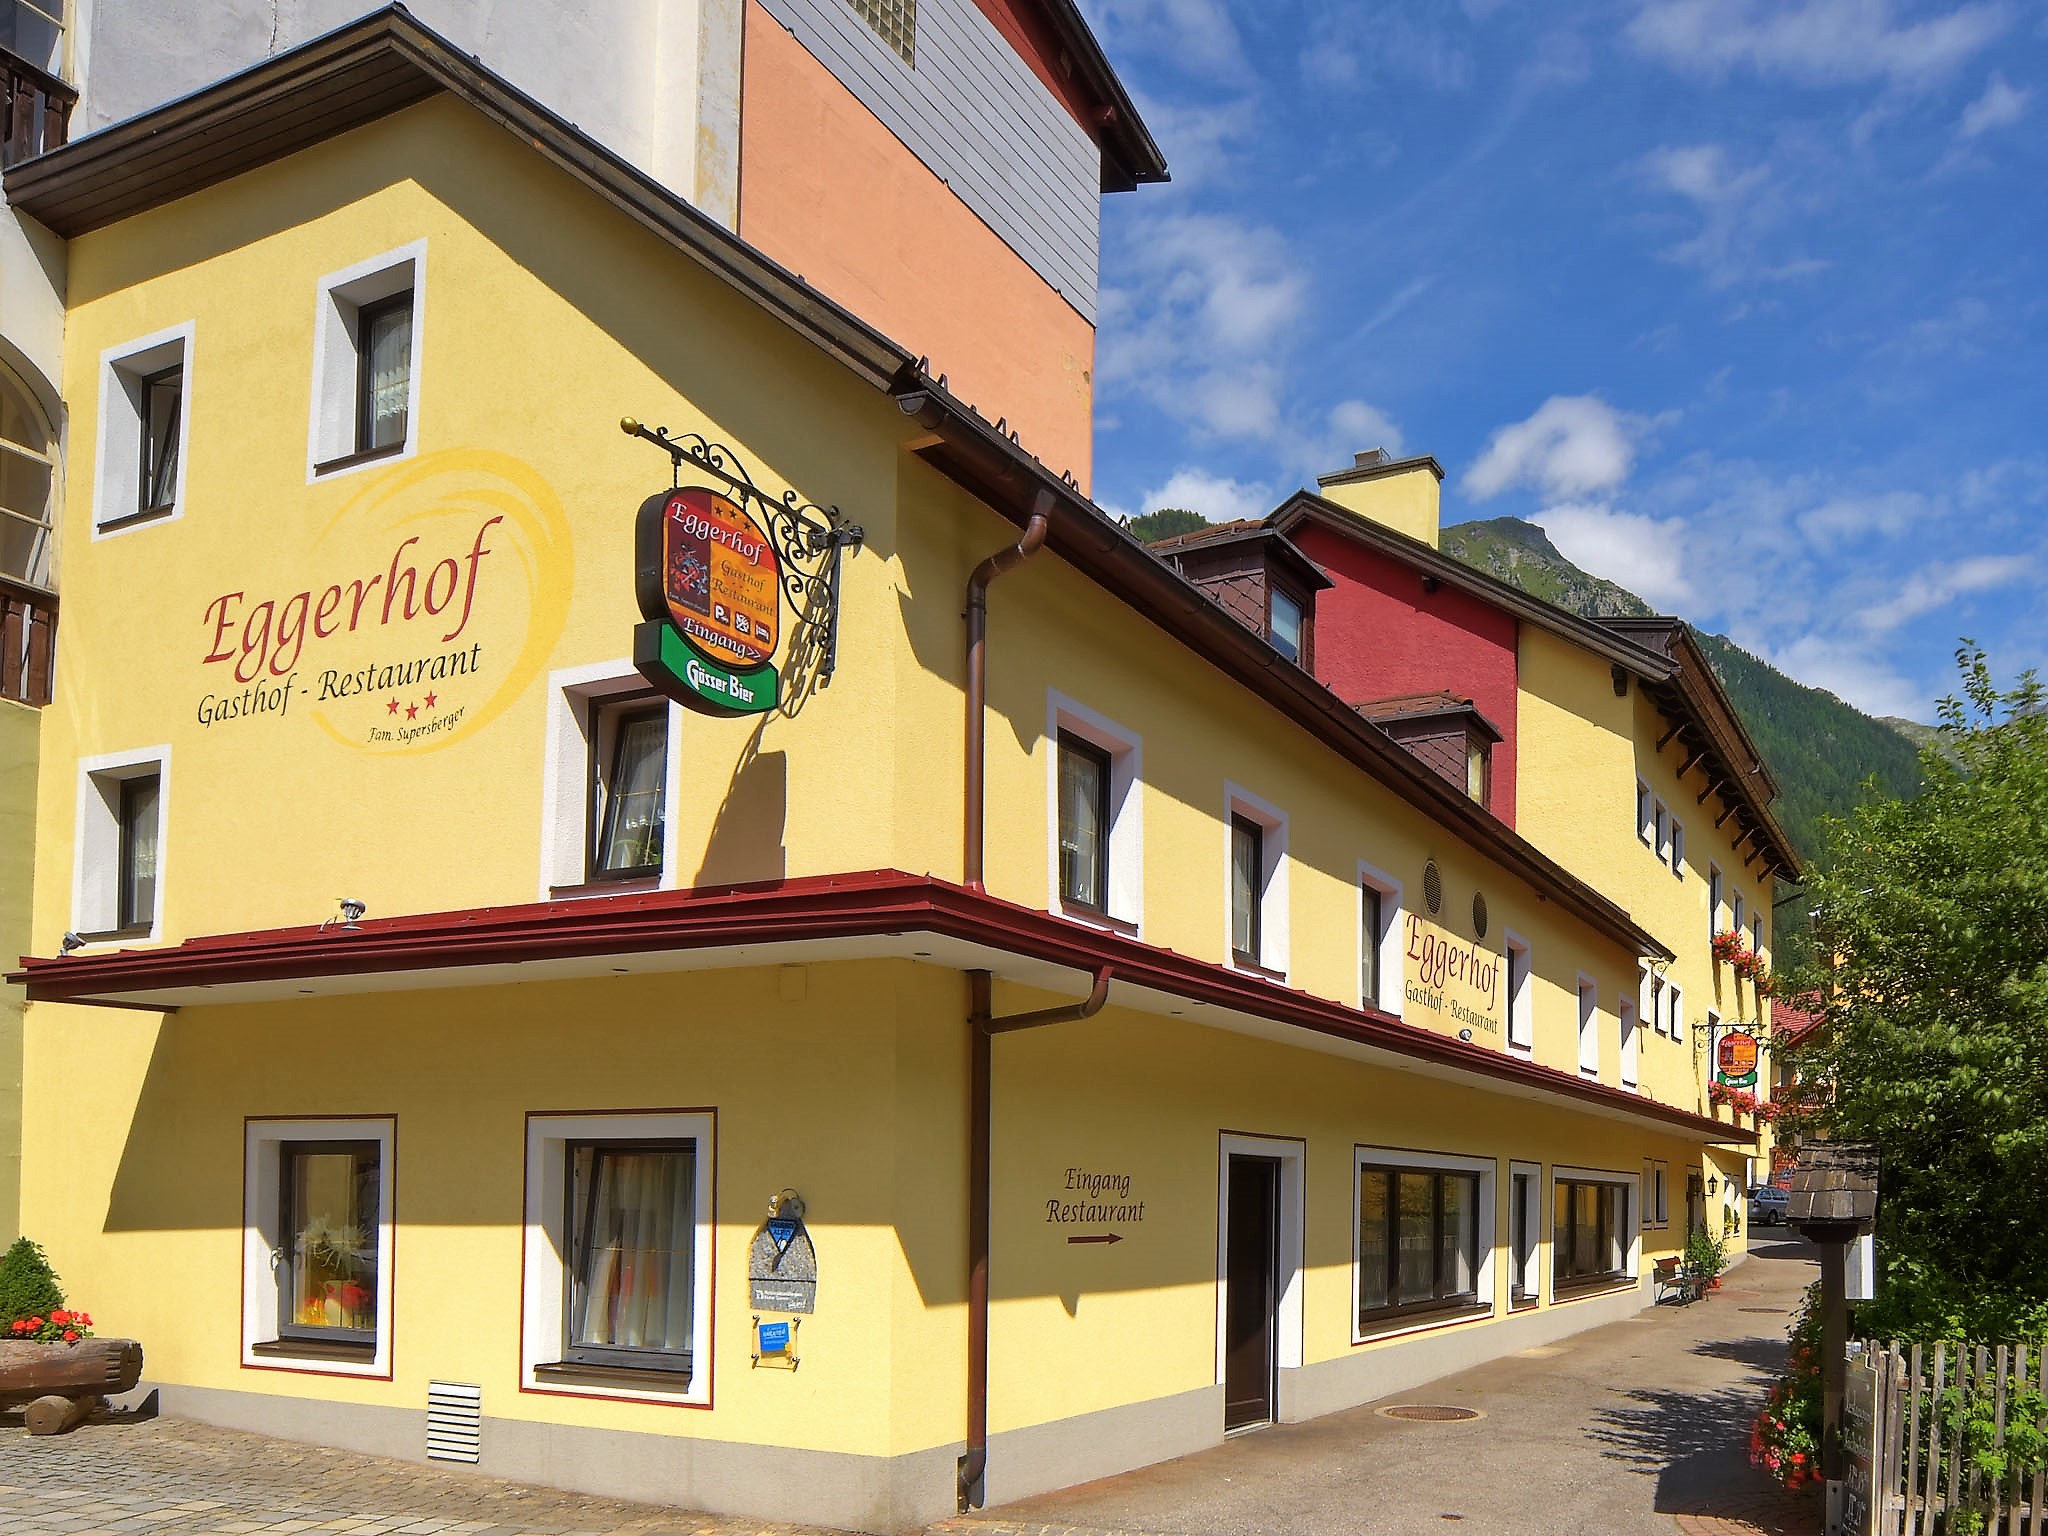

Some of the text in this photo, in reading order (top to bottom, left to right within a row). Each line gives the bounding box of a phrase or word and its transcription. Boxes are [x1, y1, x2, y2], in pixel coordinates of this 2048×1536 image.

[672, 502, 766, 566] Eggerhof
[712, 578, 775, 616] Restaurant
[721, 560, 766, 591] Gasthof
[202, 515, 504, 683] Eggerhof
[684, 616, 746, 659] Eingang
[198, 672, 298, 728] Gasthof
[317, 642, 482, 702] Restaurant
[686, 660, 754, 703] Gösser Bier
[397, 706, 465, 745] Supersberger
[1406, 913, 1501, 1011] Eggerhof
[1405, 979, 1445, 1016] Gasthof
[1450, 999, 1498, 1035] Restaurant
[1064, 1168, 1130, 1199] Eingang
[1046, 1199, 1145, 1222] Restaurant
